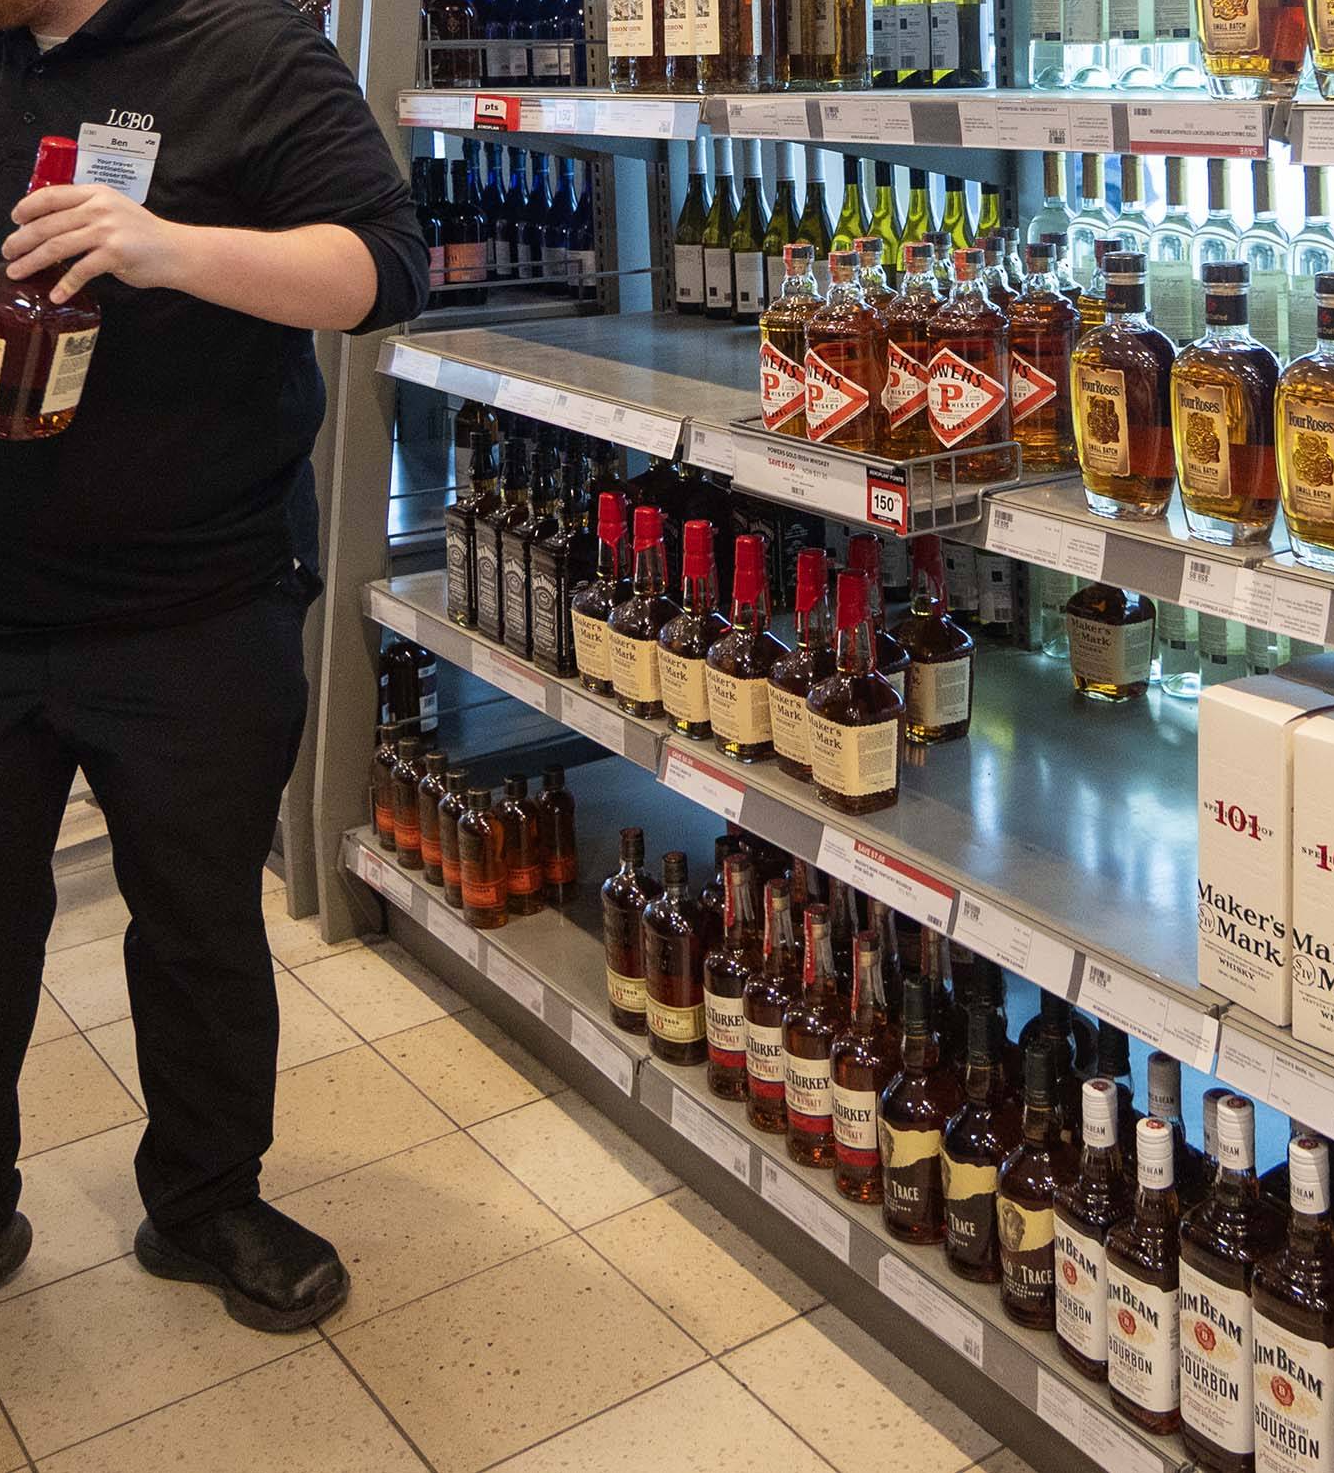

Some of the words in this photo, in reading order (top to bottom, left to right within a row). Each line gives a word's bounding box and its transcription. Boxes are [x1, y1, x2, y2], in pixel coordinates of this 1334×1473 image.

[105, 109, 154, 131] LCBO
[484, 103, 499, 112] pts
[111, 137, 128, 147] Ben
[930, 363, 985, 389] OWERS
[873, 493, 894, 512] 150
[713, 685, 737, 702] Mark
[776, 704, 802, 722] Mark
[815, 732, 842, 750] Mark
[1214, 799, 1262, 842] 101
[1198, 878, 1287, 939] Maker's
[1216, 915, 1286, 968] Mark
[1218, 956, 1256, 981] WHISKY
[788, 1072, 830, 1090] TURKEY
[834, 1102, 872, 1123] TURKEY
[892, 1179, 920, 1201] TRACE
[949, 1212, 976, 1237] TRACE
[1065, 1232, 1098, 1282] BEAM
[1021, 1264, 1053, 1284] TRACE
[1121, 1282, 1160, 1328] BEAM
[1179, 1286, 1198, 1314] JIM
[1199, 1295, 1243, 1346] BEAM
[1108, 1334, 1153, 1376] BOURBON
[1180, 1357, 1240, 1403] BOURBON
[1255, 1340, 1275, 1369] JIM
[1276, 1345, 1324, 1402] BEAM
[1255, 1405, 1320, 1461] BOURBON
